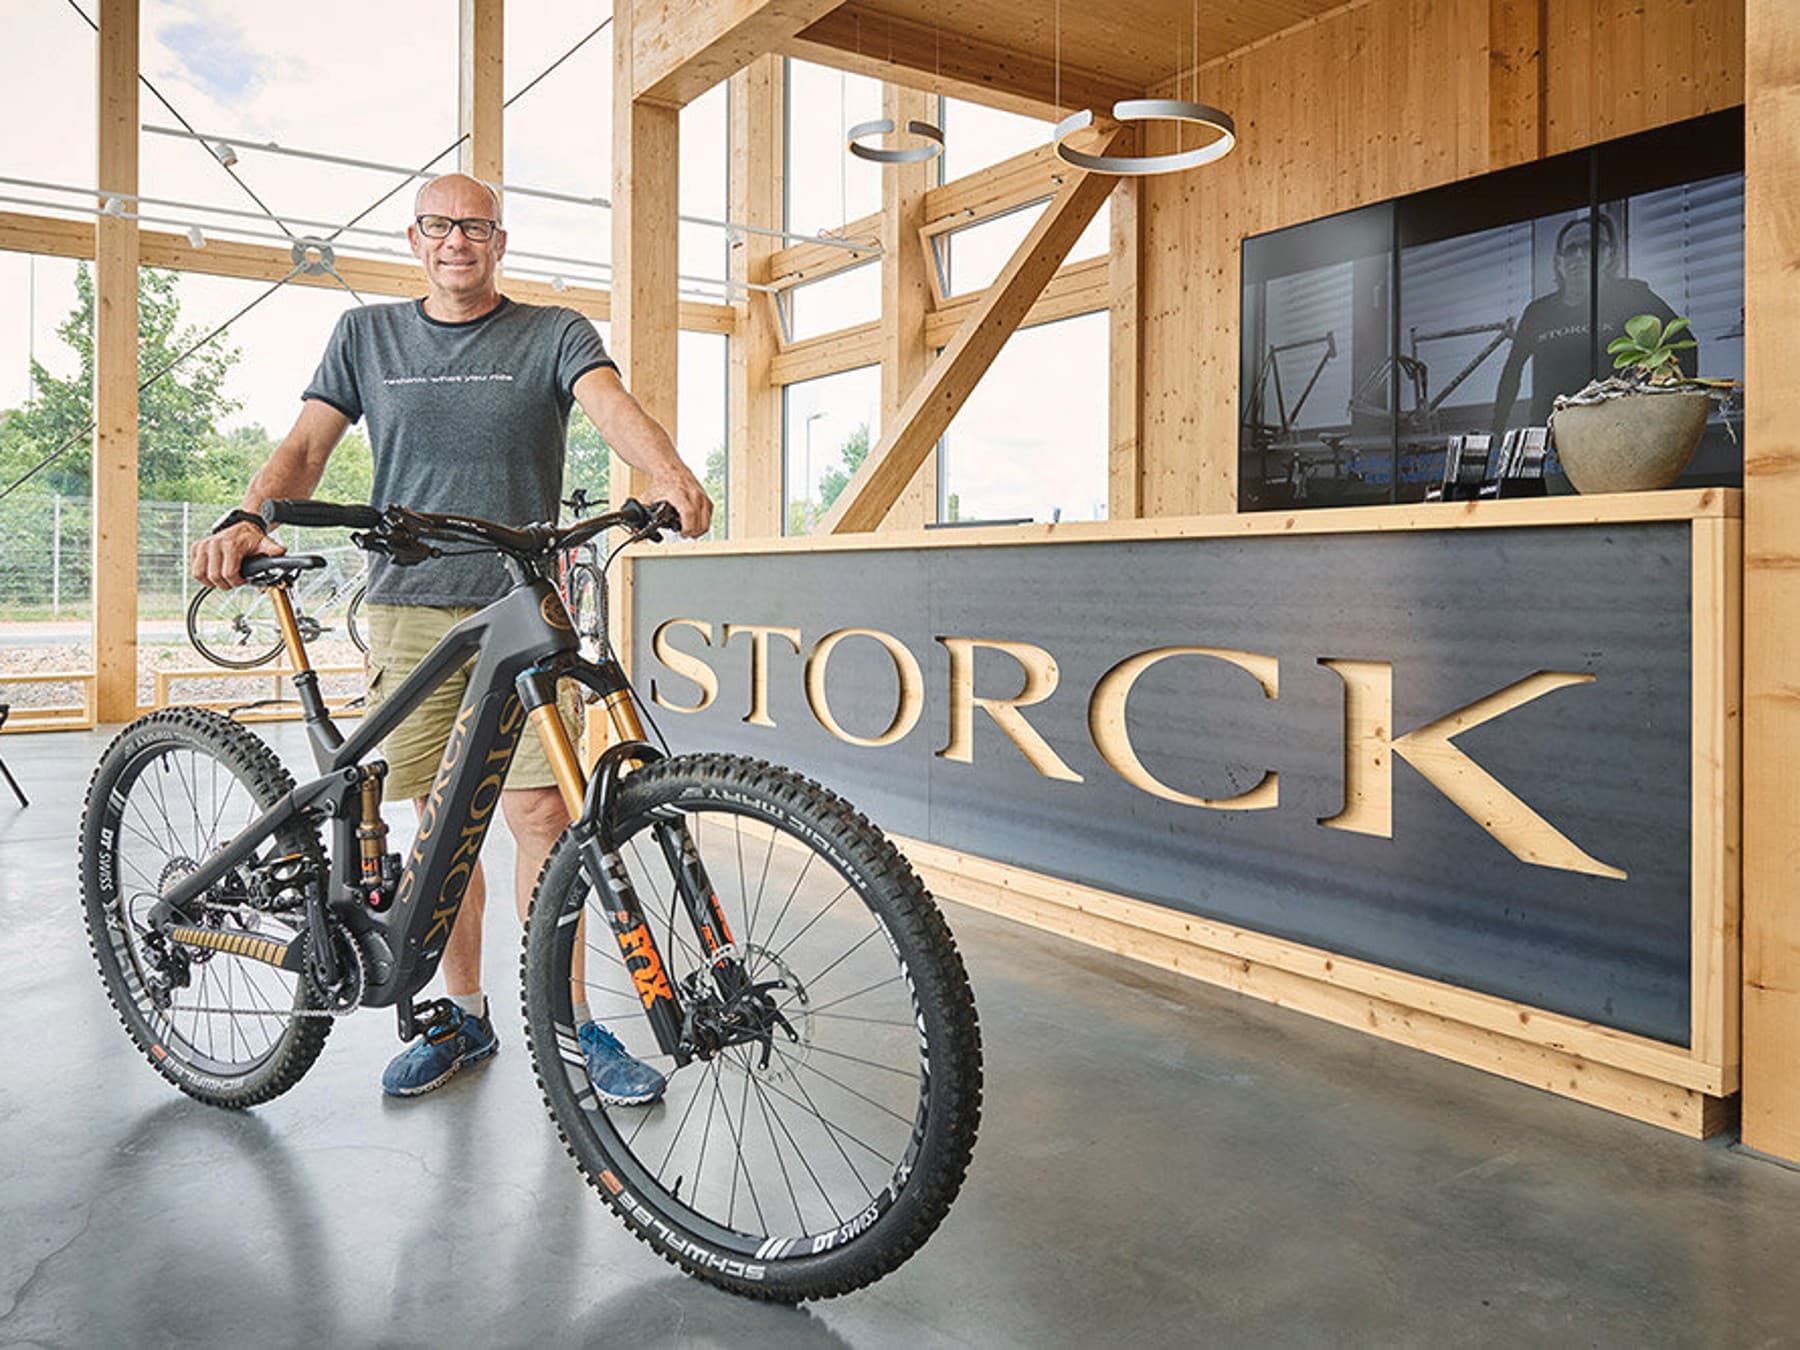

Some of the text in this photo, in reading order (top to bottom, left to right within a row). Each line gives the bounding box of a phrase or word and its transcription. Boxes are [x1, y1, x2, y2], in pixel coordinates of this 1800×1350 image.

[430, 374, 462, 383] what
[464, 374, 487, 383] you
[651, 618, 1629, 881] STORCK
[423, 692, 524, 947] STORCK
[708, 786, 785, 822] MARY
[101, 827, 114, 850] DT
[99, 851, 112, 891] SWISS
[618, 922, 674, 1010] FOX
[617, 1190, 766, 1281] SCHWALBE
[812, 1204, 878, 1253] DT SWISS
